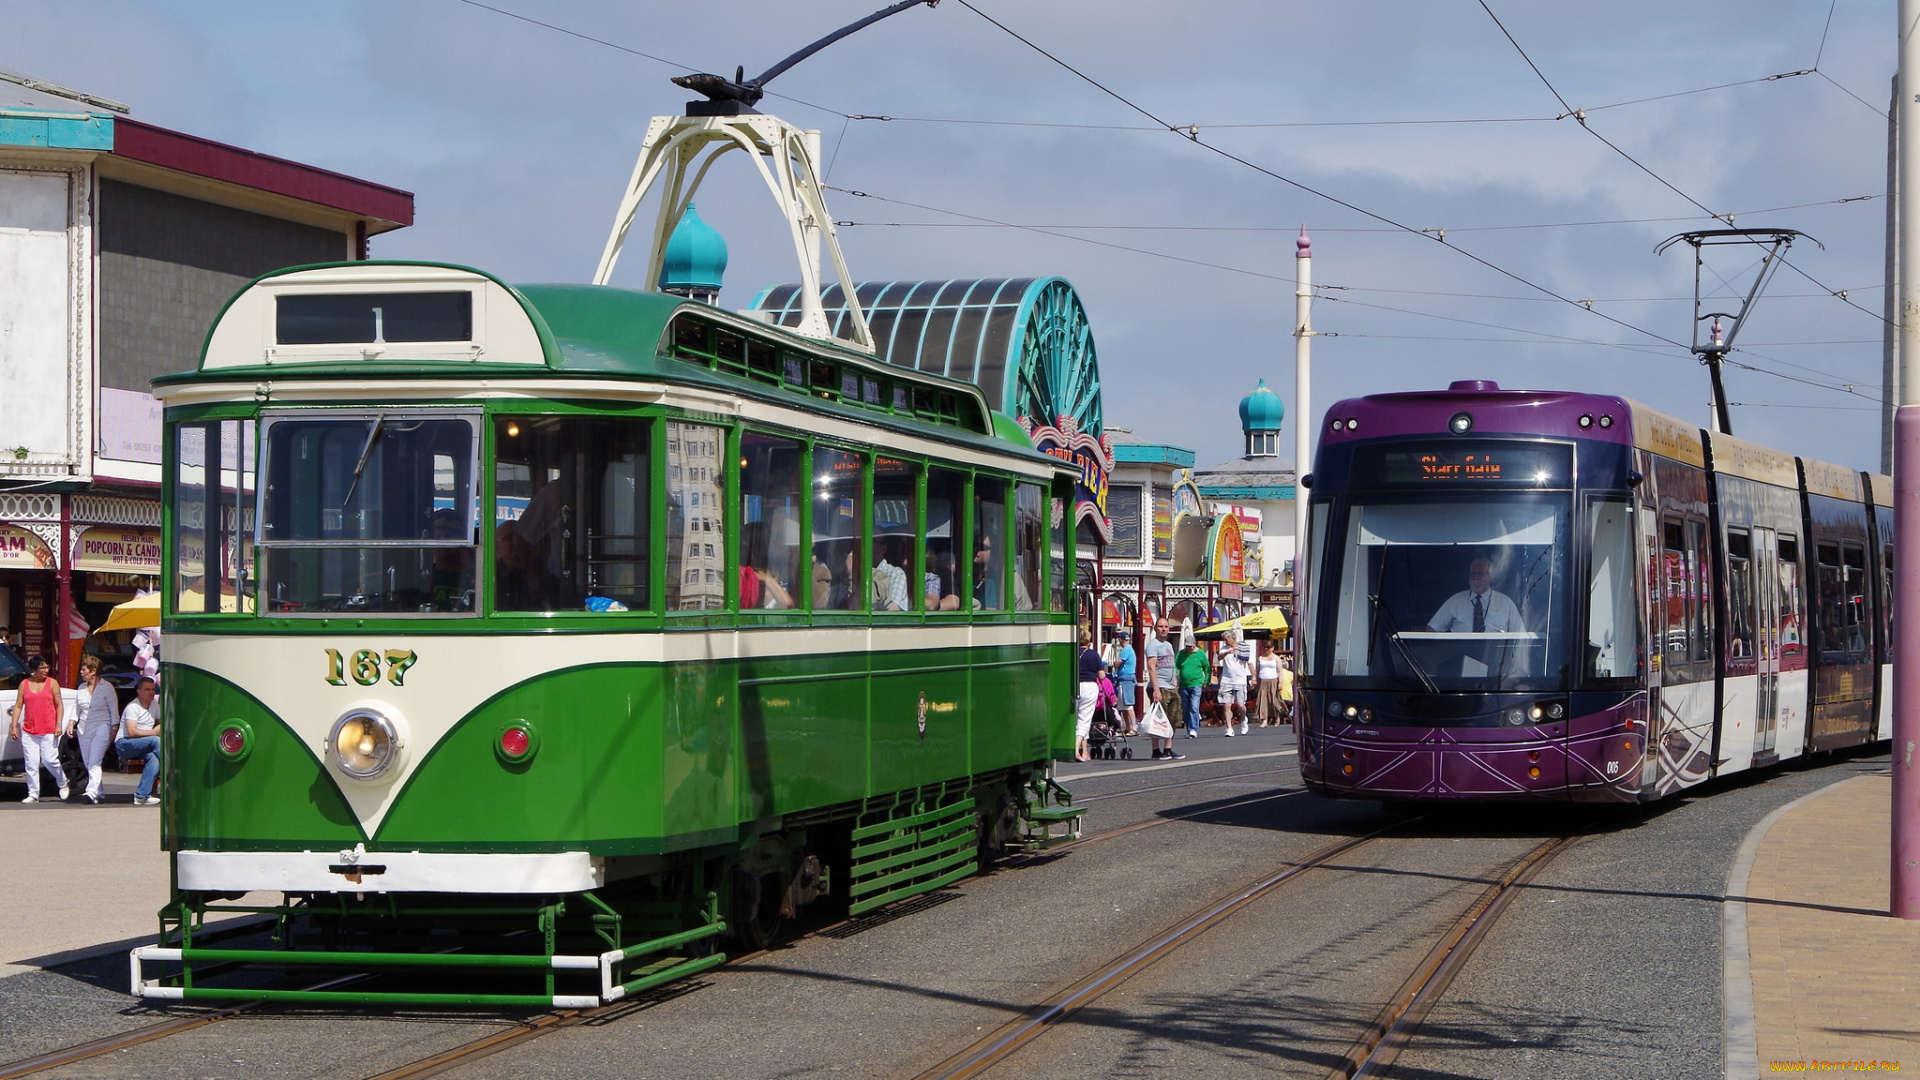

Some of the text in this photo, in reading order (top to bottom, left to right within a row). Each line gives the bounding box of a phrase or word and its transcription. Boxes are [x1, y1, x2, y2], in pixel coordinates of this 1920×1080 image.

[372, 307, 386, 343] 1
[1421, 455, 1501, 479] Starr Gate
[121, 534, 154, 544] FRESHLY MADE
[85, 540, 161, 558] POPCORN & CANDY
[113, 555, 123, 564] HOT
[130, 556, 143, 565] COLD
[324, 648, 418, 687] 167
[1607, 761, 1619, 774] 005
